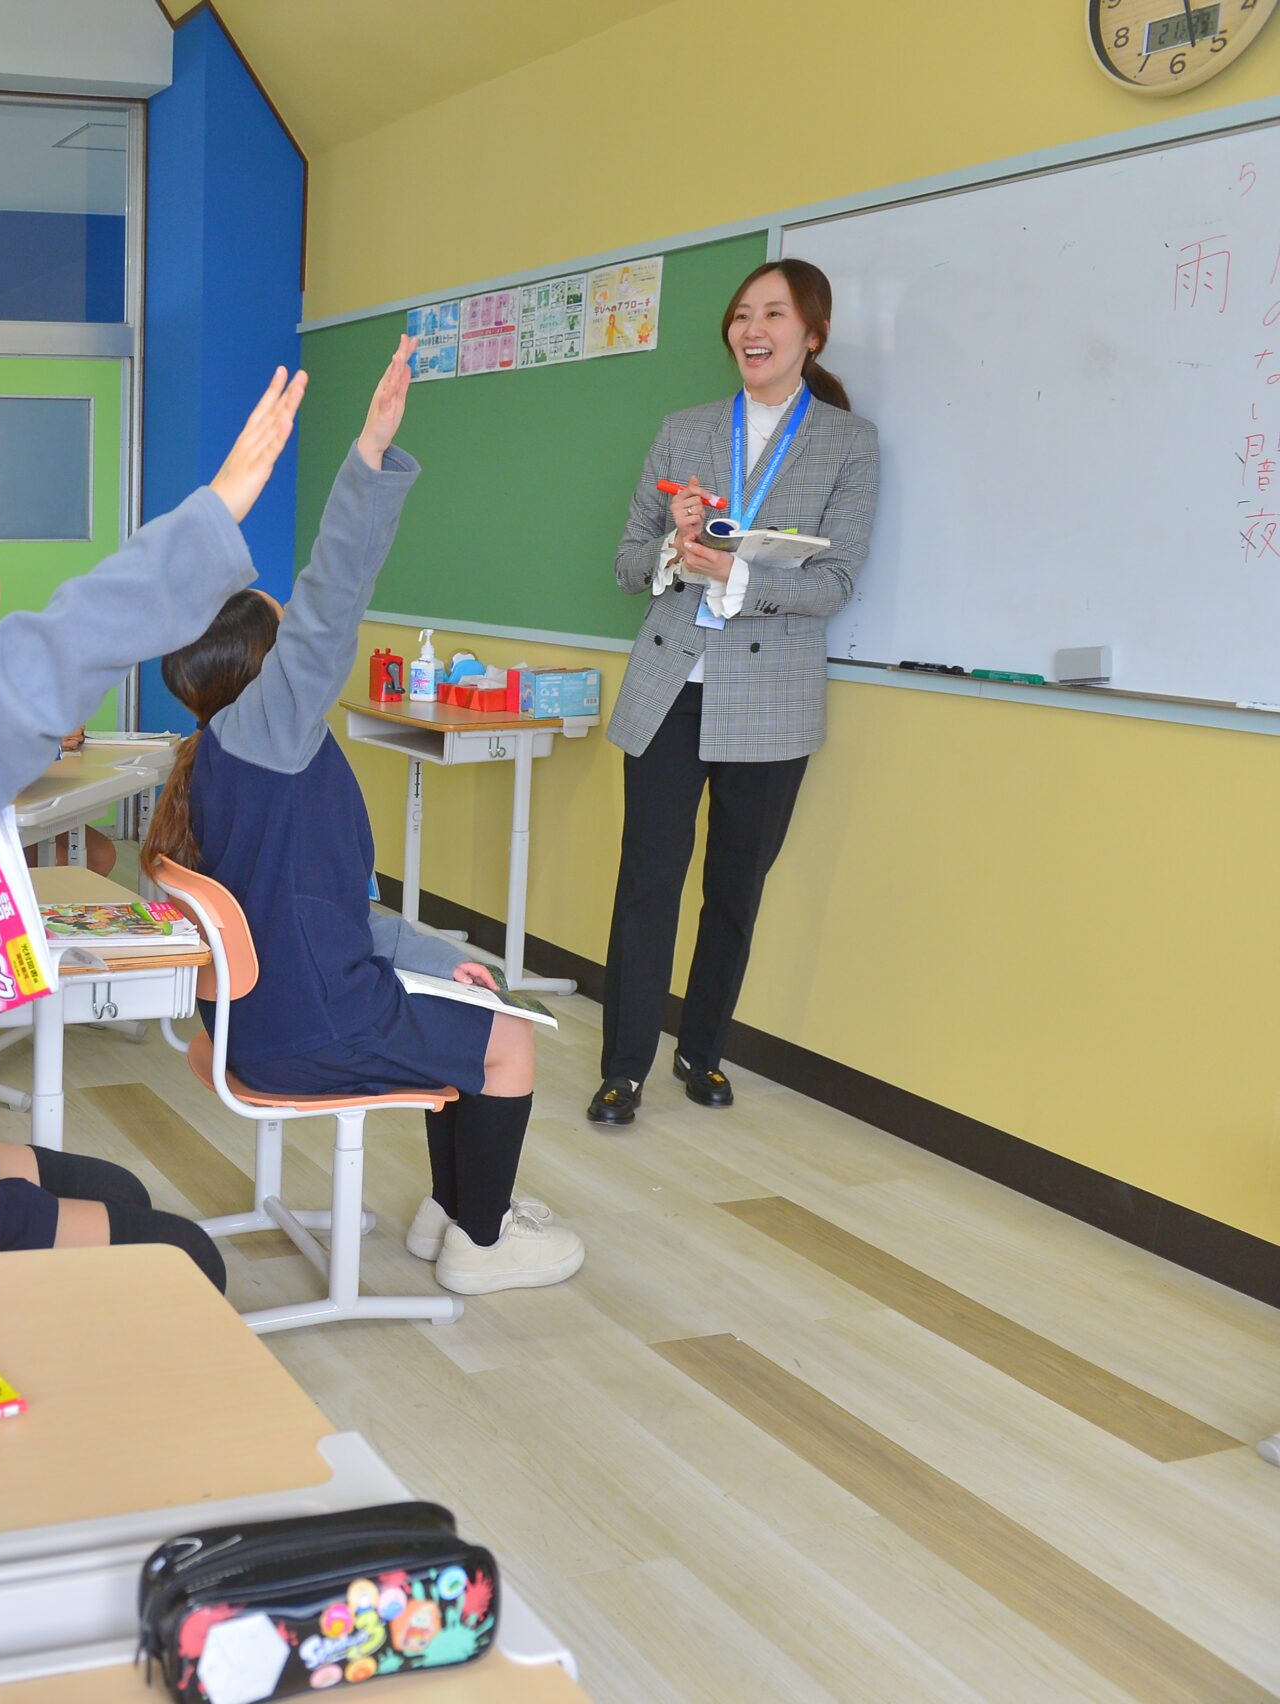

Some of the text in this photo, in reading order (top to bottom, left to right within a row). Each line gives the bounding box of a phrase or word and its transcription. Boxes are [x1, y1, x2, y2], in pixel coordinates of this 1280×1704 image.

[1113, 27, 1130, 49] 8
[1209, 29, 1228, 53] 5
[1169, 52, 1187, 75] 6
[1173, 233, 1231, 314] 雨
